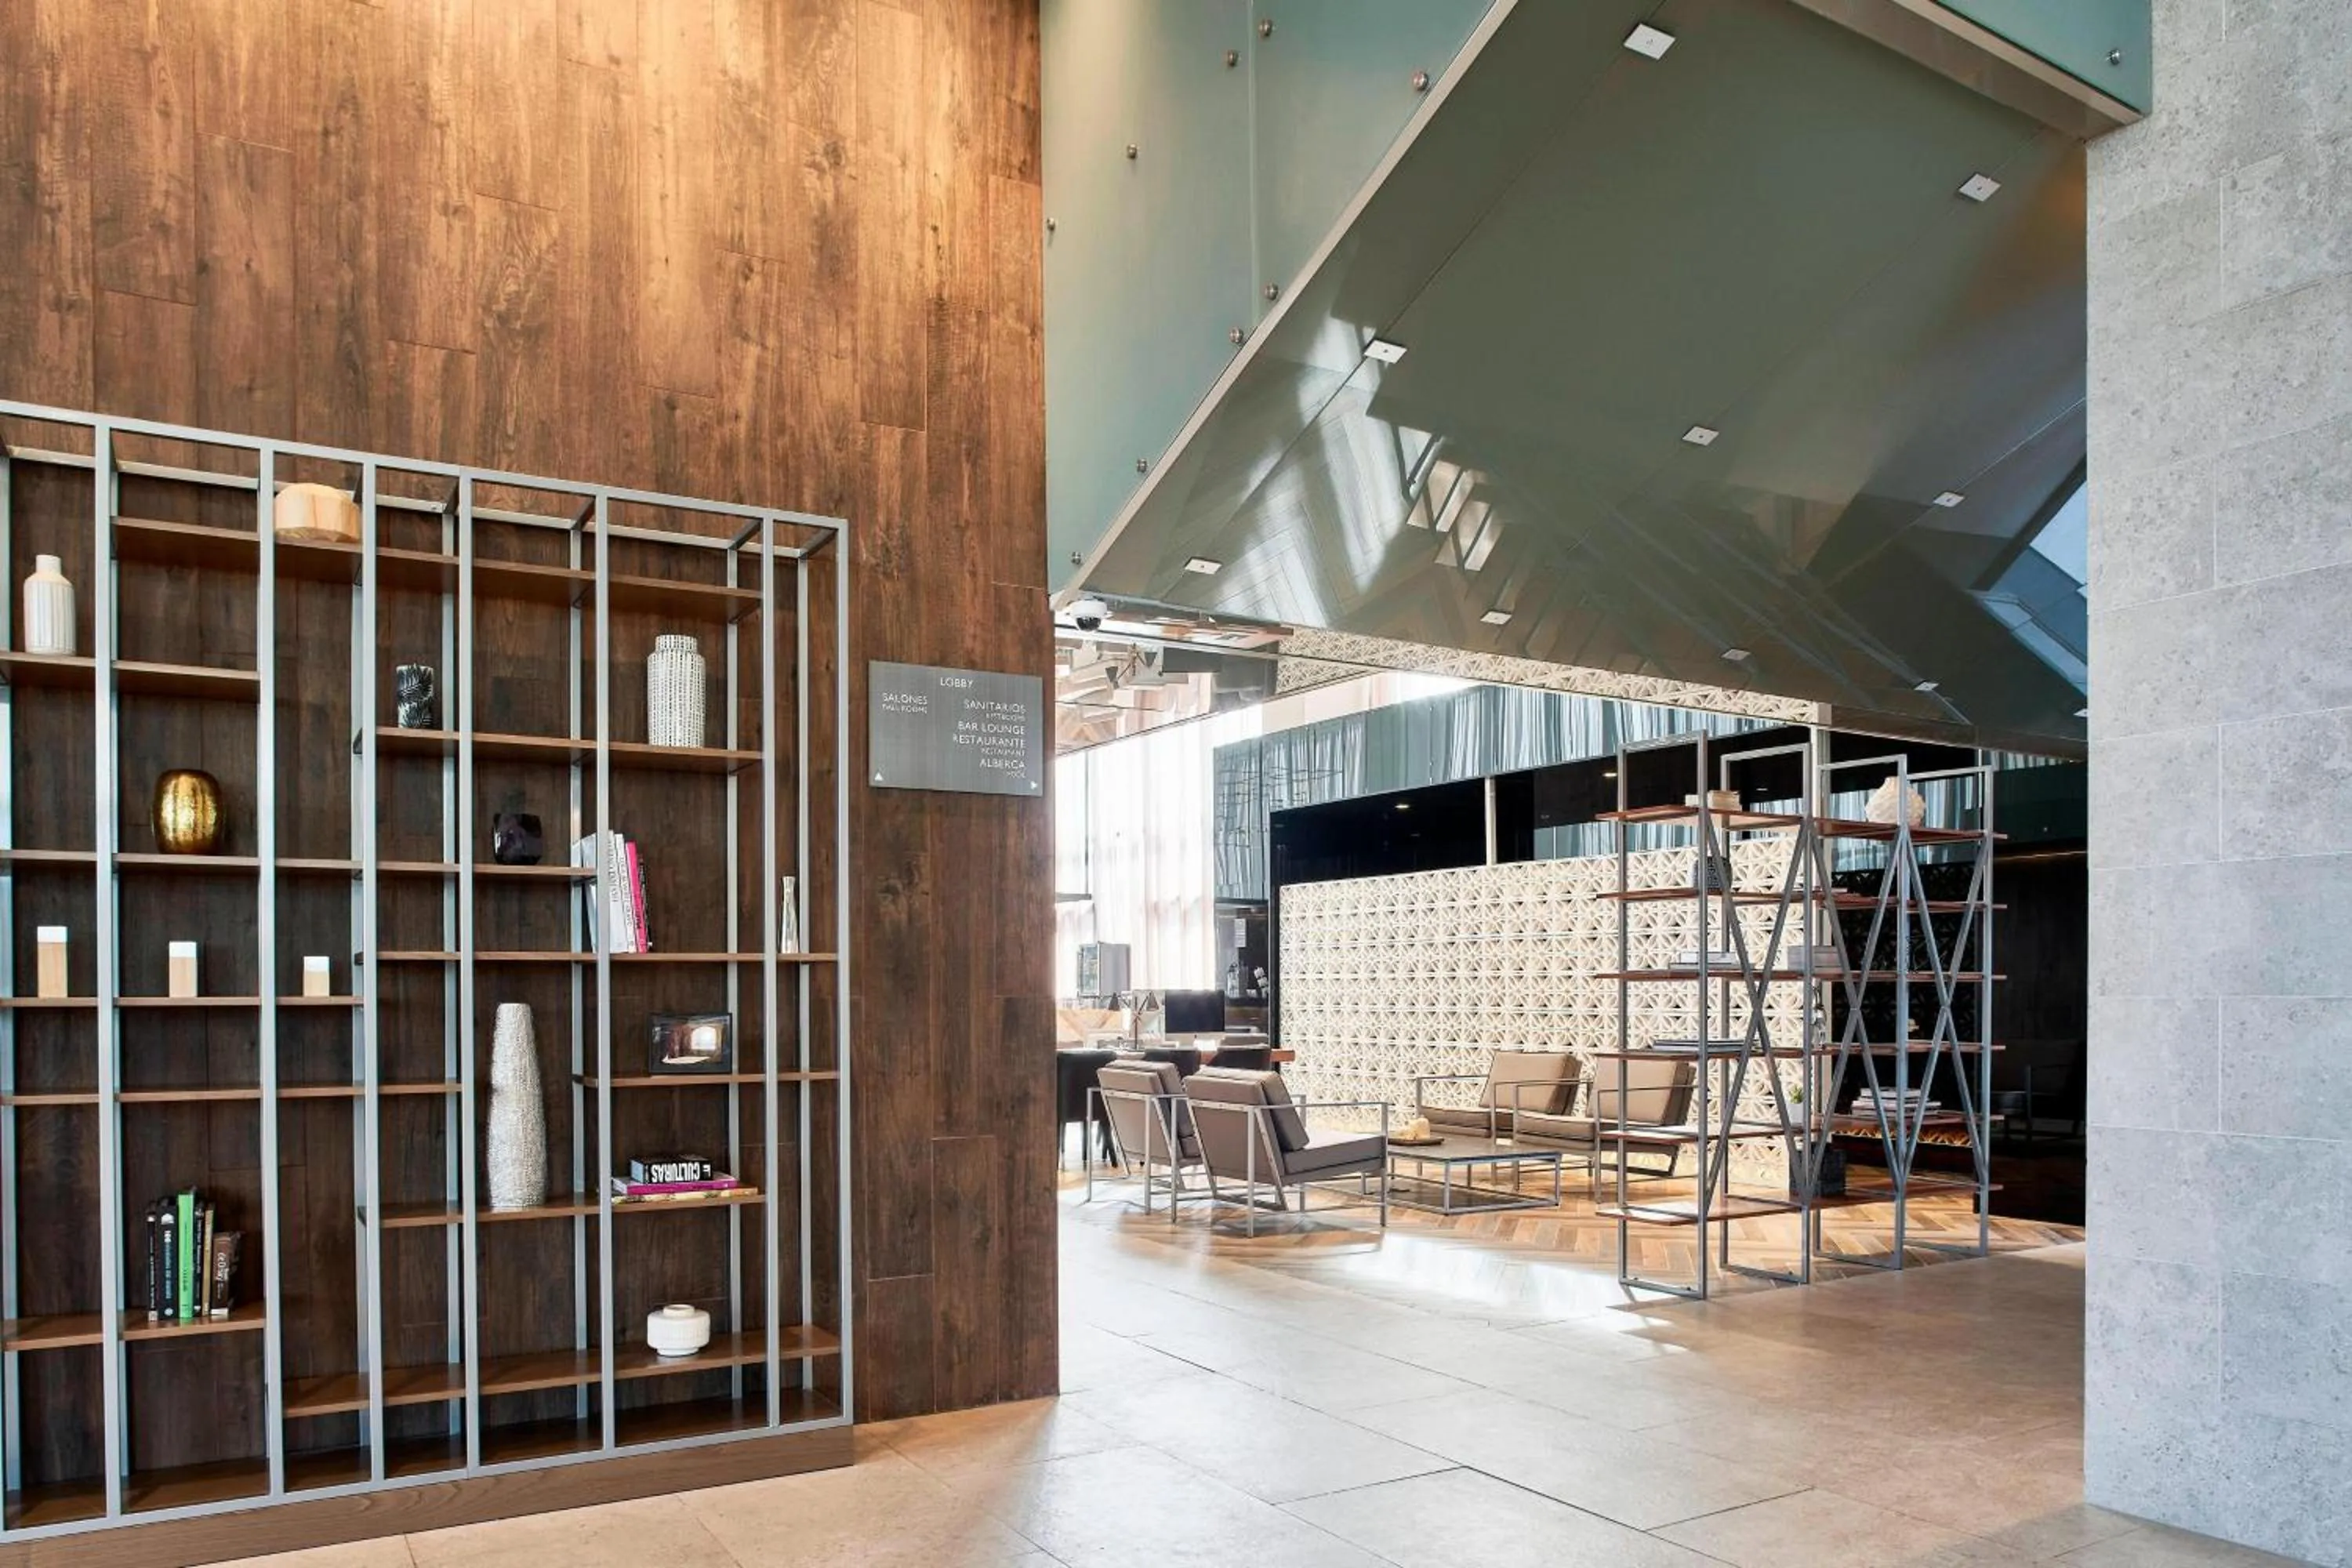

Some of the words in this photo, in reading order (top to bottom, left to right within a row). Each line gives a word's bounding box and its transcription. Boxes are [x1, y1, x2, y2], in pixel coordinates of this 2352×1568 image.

[941, 677, 973, 688] LOBBY
[882, 693, 927, 705] SALONES
[964, 699, 1026, 713] SANITARIOS
[958, 721, 978, 731] BAR
[982, 723, 1025, 735] LOUNGE
[953, 734, 1025, 748] RESTAURANTE
[980, 759, 1025, 769] ALBERCA
[651, 1162, 700, 1182] CULTURAS
